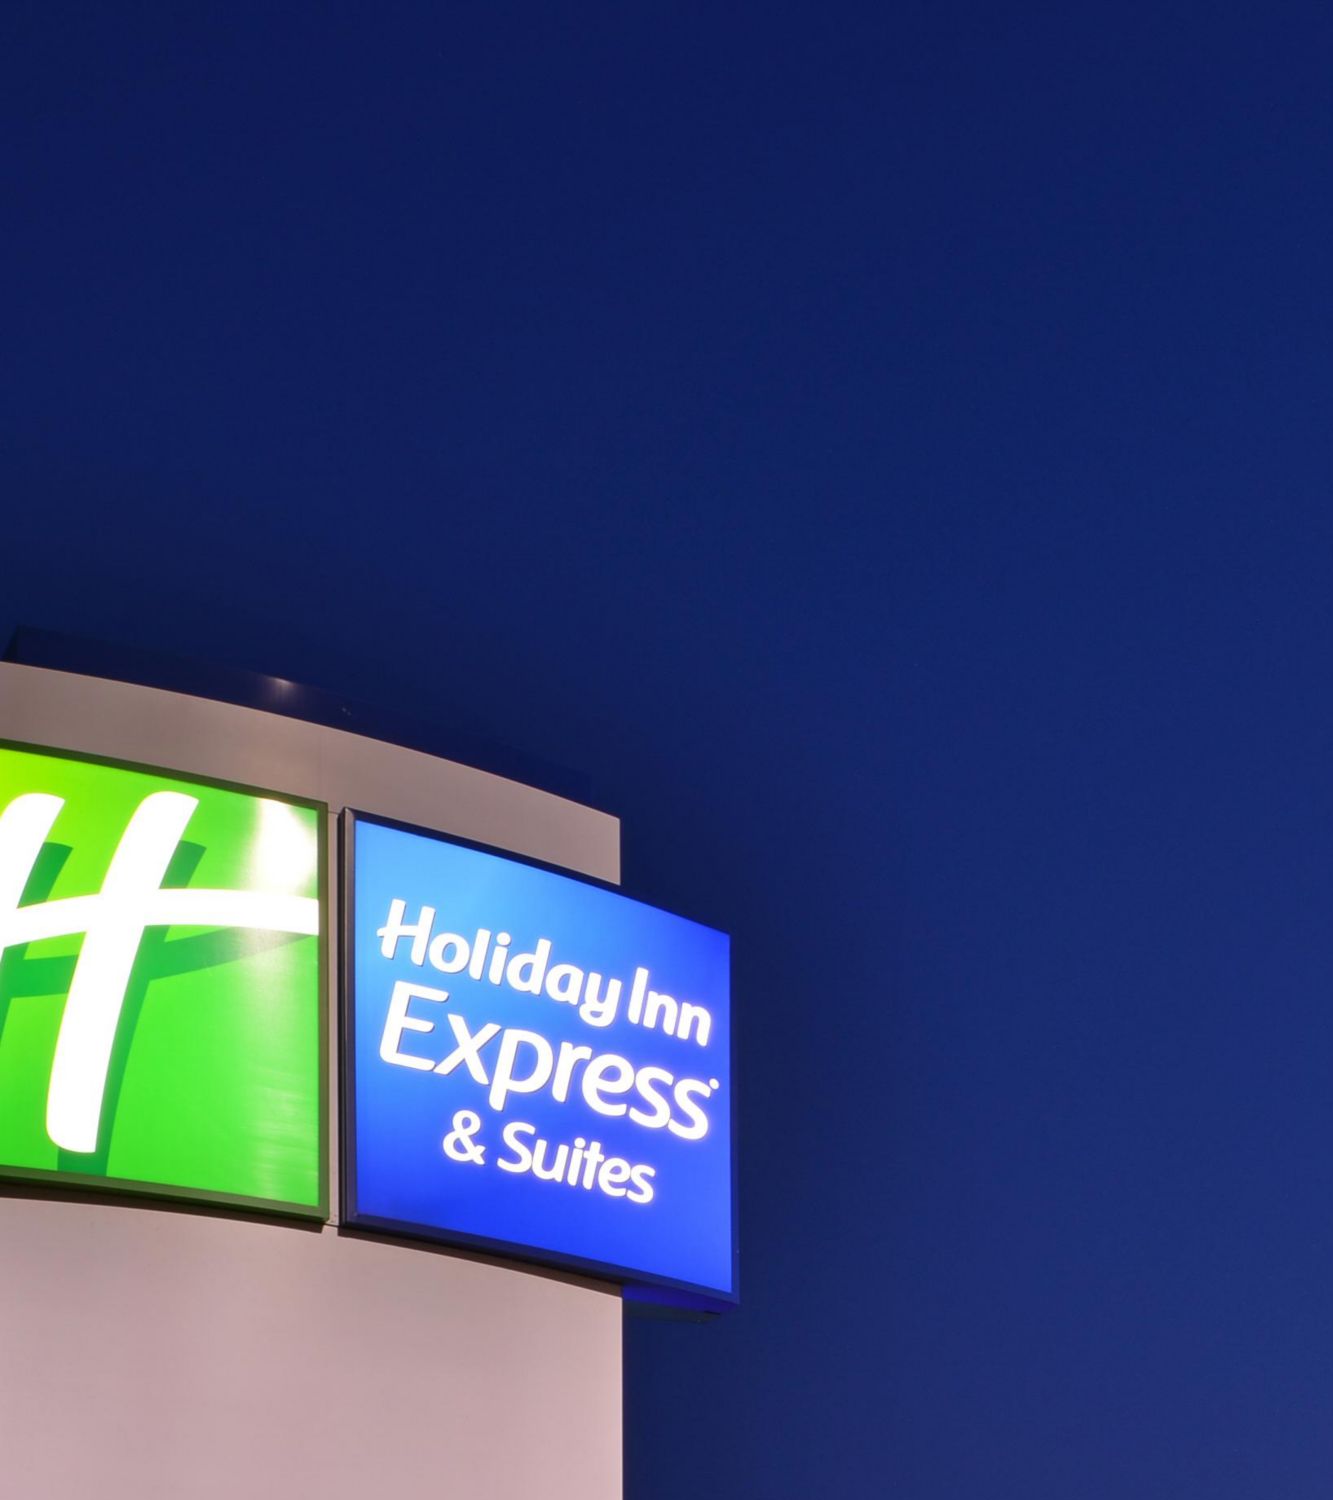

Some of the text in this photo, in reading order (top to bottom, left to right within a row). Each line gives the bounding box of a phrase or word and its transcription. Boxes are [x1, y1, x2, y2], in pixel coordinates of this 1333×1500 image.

[377, 897, 711, 1046] Holiday Inn
[379, 981, 713, 1140] Express
[443, 1110, 656, 1204] & Suites
